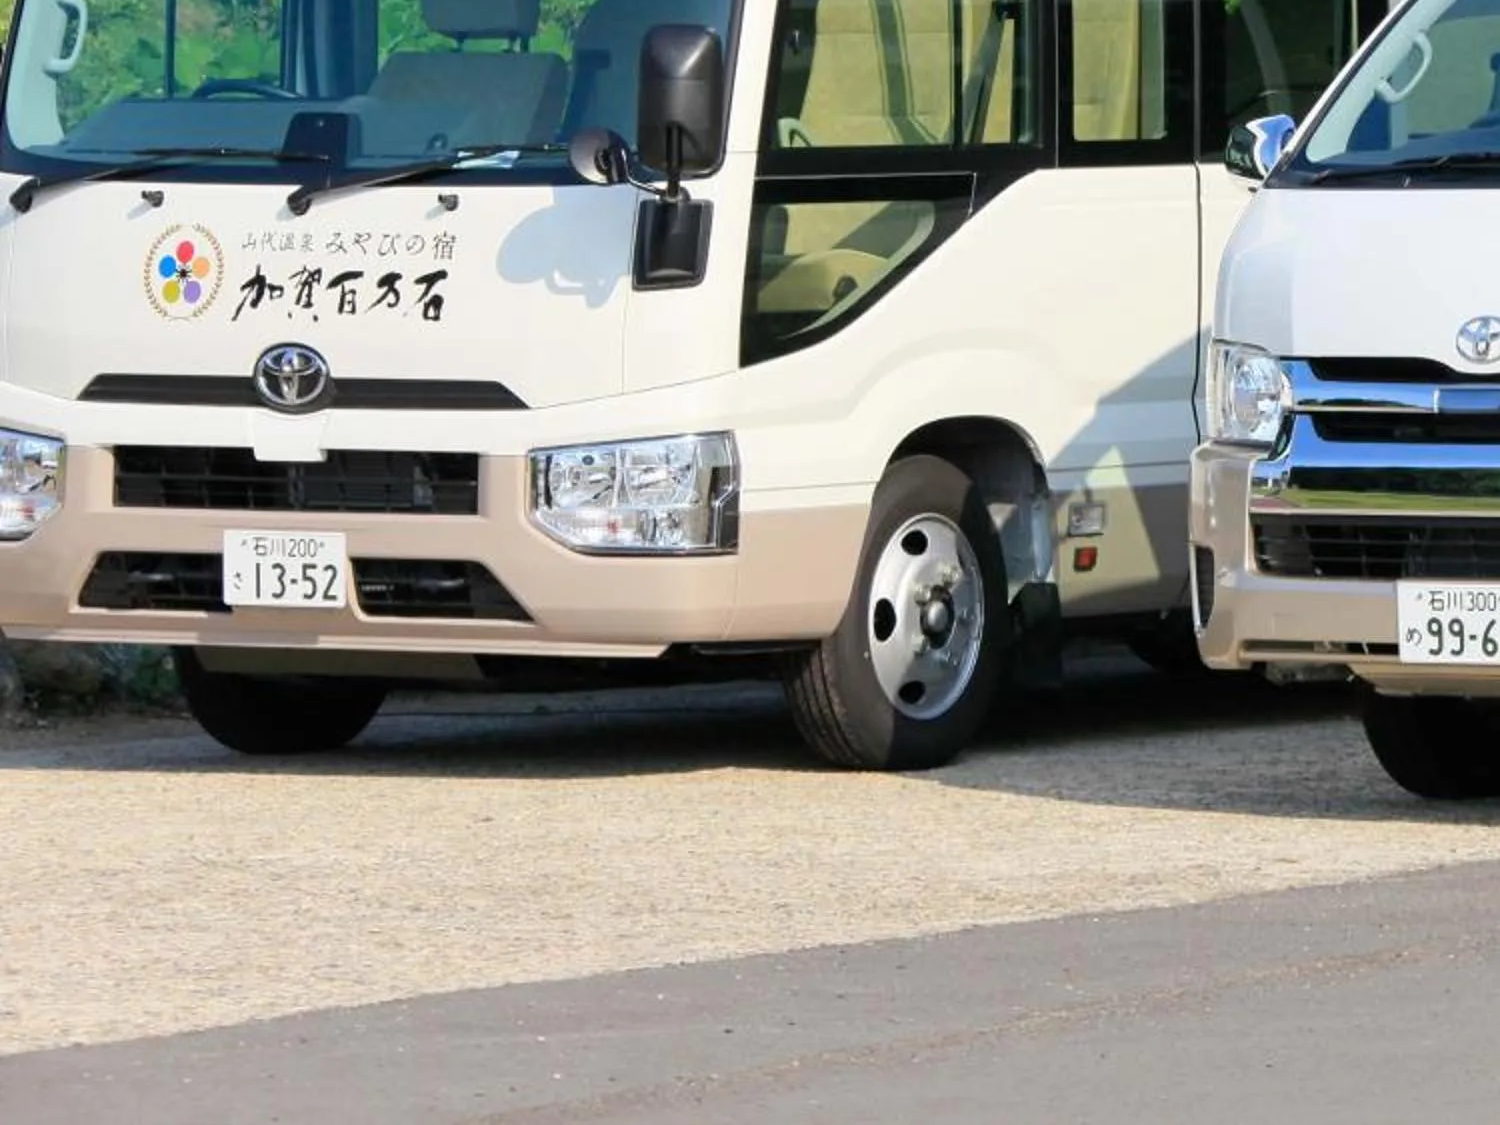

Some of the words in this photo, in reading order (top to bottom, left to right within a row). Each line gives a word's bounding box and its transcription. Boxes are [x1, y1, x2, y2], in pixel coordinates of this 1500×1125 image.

[231, 263, 449, 323] 加賀百万石
